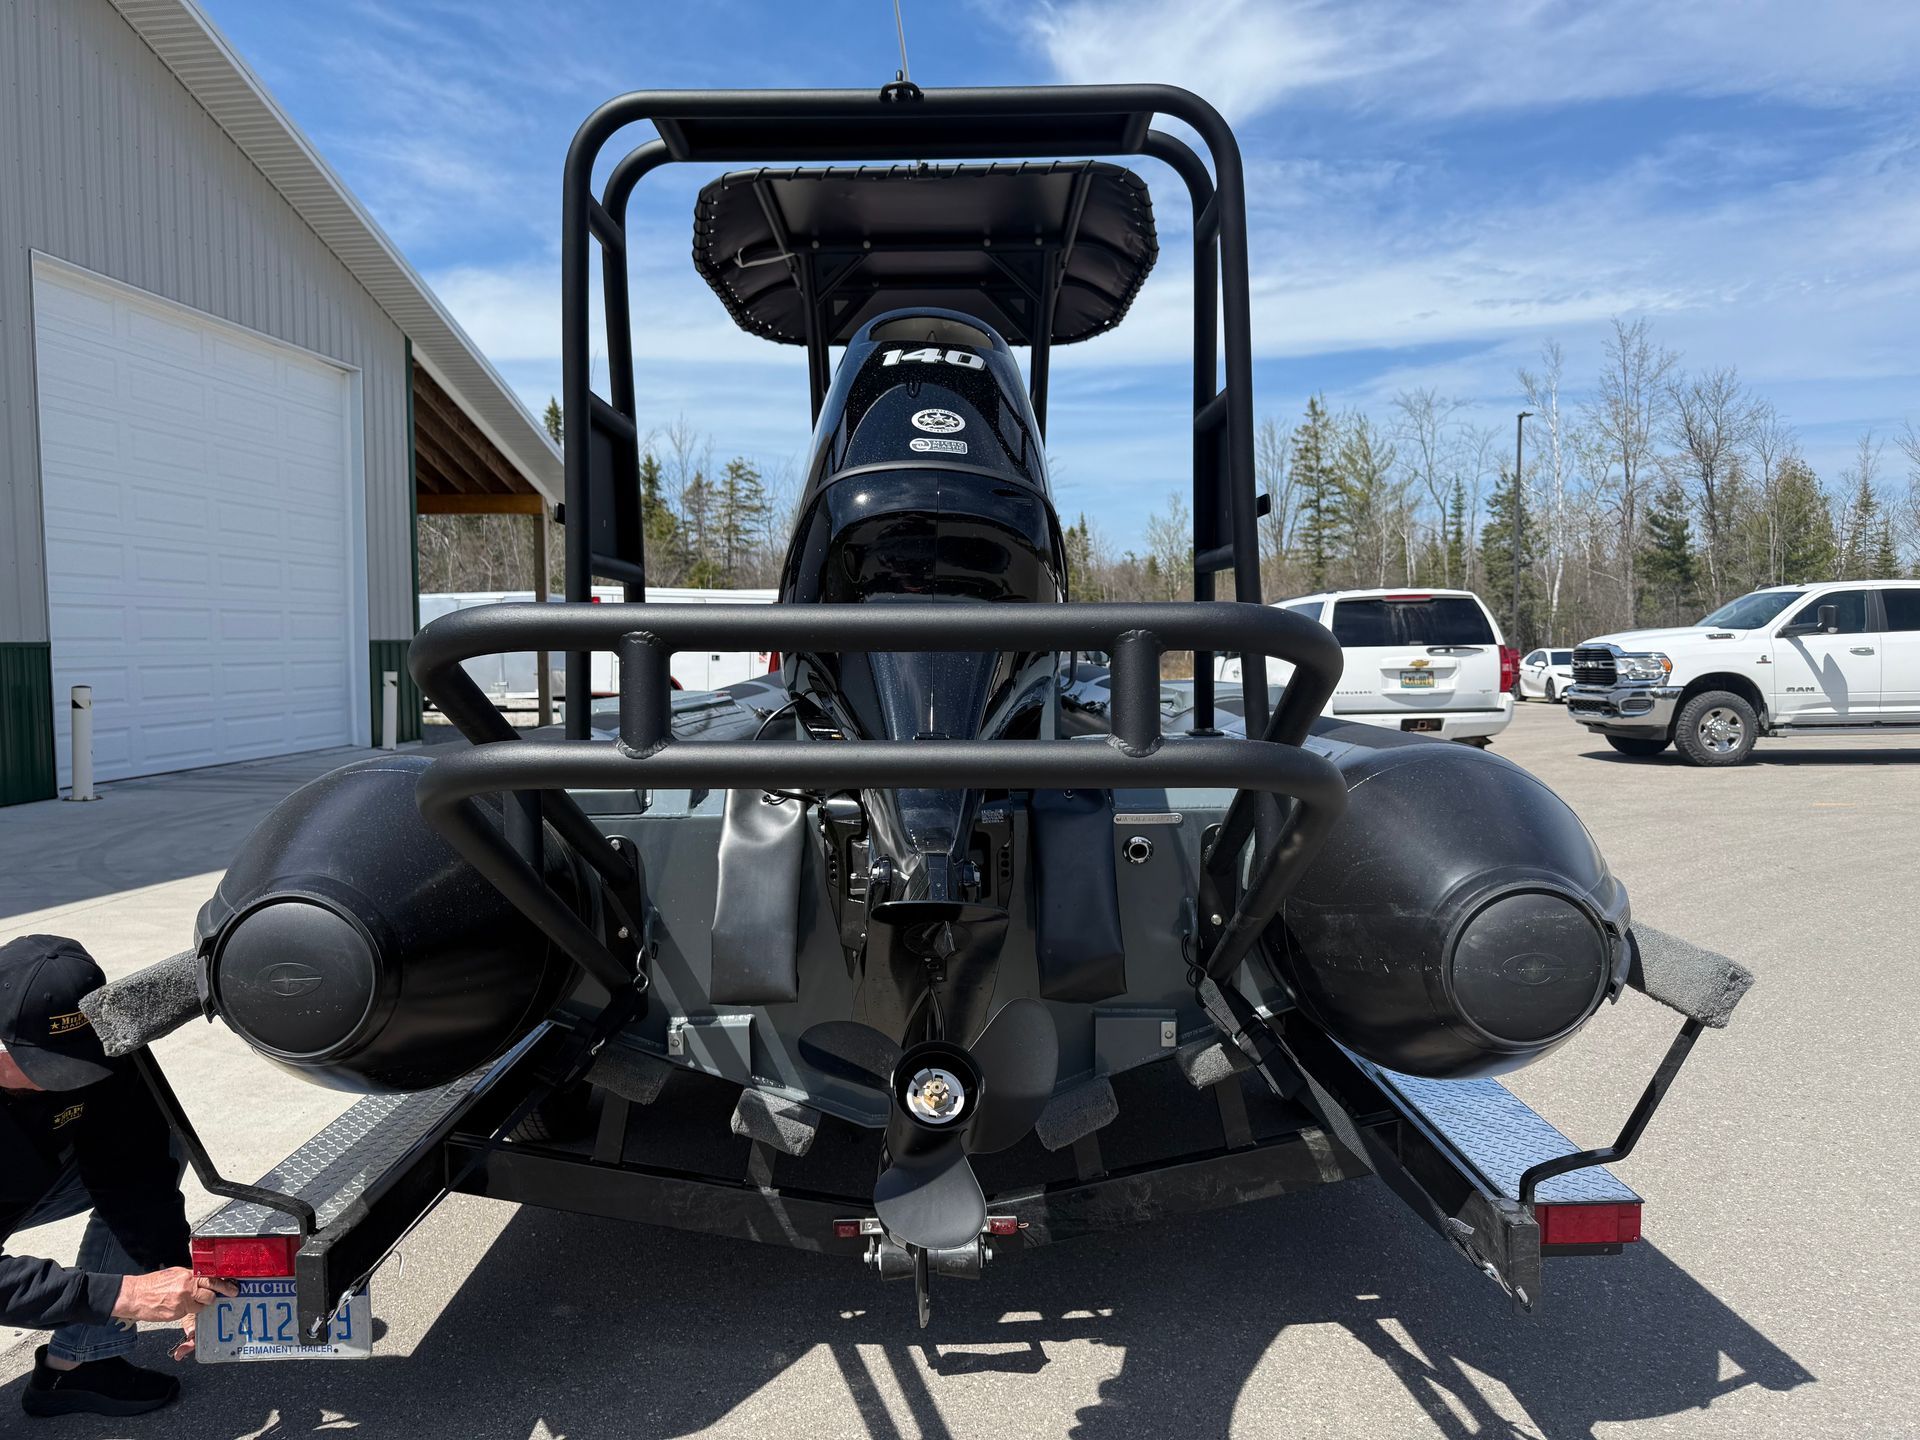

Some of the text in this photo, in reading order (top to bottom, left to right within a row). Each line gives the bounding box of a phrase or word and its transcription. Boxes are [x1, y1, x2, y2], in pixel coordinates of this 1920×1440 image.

[882, 348, 986, 371] 140
[240, 1282, 298, 1294] MICHIG
[217, 1302, 352, 1343] C4129
[237, 1344, 333, 1355] PERMANENT TRAILER
